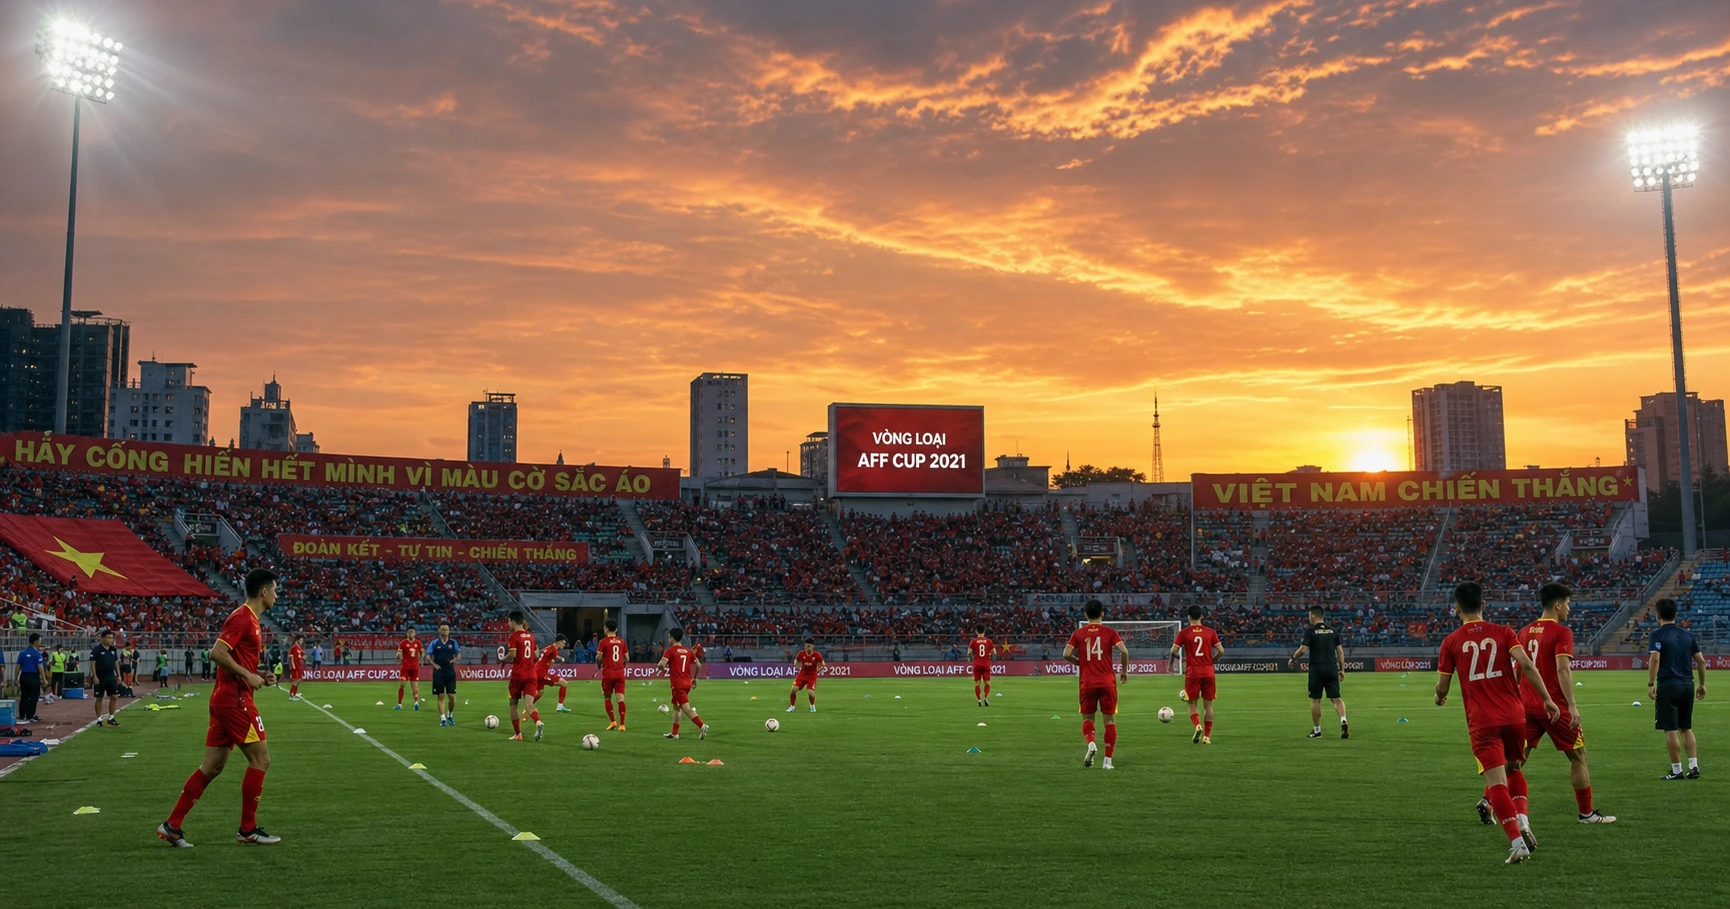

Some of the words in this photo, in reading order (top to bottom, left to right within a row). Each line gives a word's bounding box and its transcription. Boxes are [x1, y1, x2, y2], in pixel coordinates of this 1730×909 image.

[872, 428, 913, 446] VÒNG
[915, 432, 946, 449] LOẠI
[86, 440, 169, 473] CỐNG
[261, 453, 316, 481] HẾT
[325, 457, 396, 486] MÌNH
[405, 461, 432, 487] VÌ
[441, 463, 499, 489] MÀU
[508, 465, 546, 491] CỜ
[554, 466, 607, 492] SẮC
[615, 469, 651, 493] ÁO
[857, 452, 889, 468] AFF
[892, 452, 926, 469] CUP
[929, 453, 966, 469] 2021
[1212, 477, 1297, 508] VIỆT
[1310, 481, 1386, 502] NAM
[1398, 471, 1500, 502] CHIẾN
[1511, 468, 1619, 499] THẮNG
[293, 538, 341, 555] ĐOÀN
[347, 538, 380, 557] KẾT
[398, 543, 422, 561] TỰ
[425, 545, 453, 558] TIN
[469, 542, 518, 559] CHIẾN
[522, 542, 577, 561] THẮNG
[612, 645, 620, 662] 8
[979, 644, 985, 657] 8
[1084, 636, 1103, 661] 14
[1193, 635, 1204, 657] 2
[680, 655, 687, 672] 7
[1045, 662, 1071, 674] VÒNG
[1138, 663, 1157, 673] 2021
[1462, 637, 1503, 682] 22
[346, 669, 366, 679] AFF
[367, 669, 388, 679] CUP
[389, 669, 400, 679] 20
[460, 667, 483, 679] VÒNG
[633, 668, 655, 677] CUP
[729, 664, 758, 676] VÒNG
[829, 666, 851, 676] 2021
[893, 663, 921, 675] VÒNG
[946, 665, 965, 675] AFF
